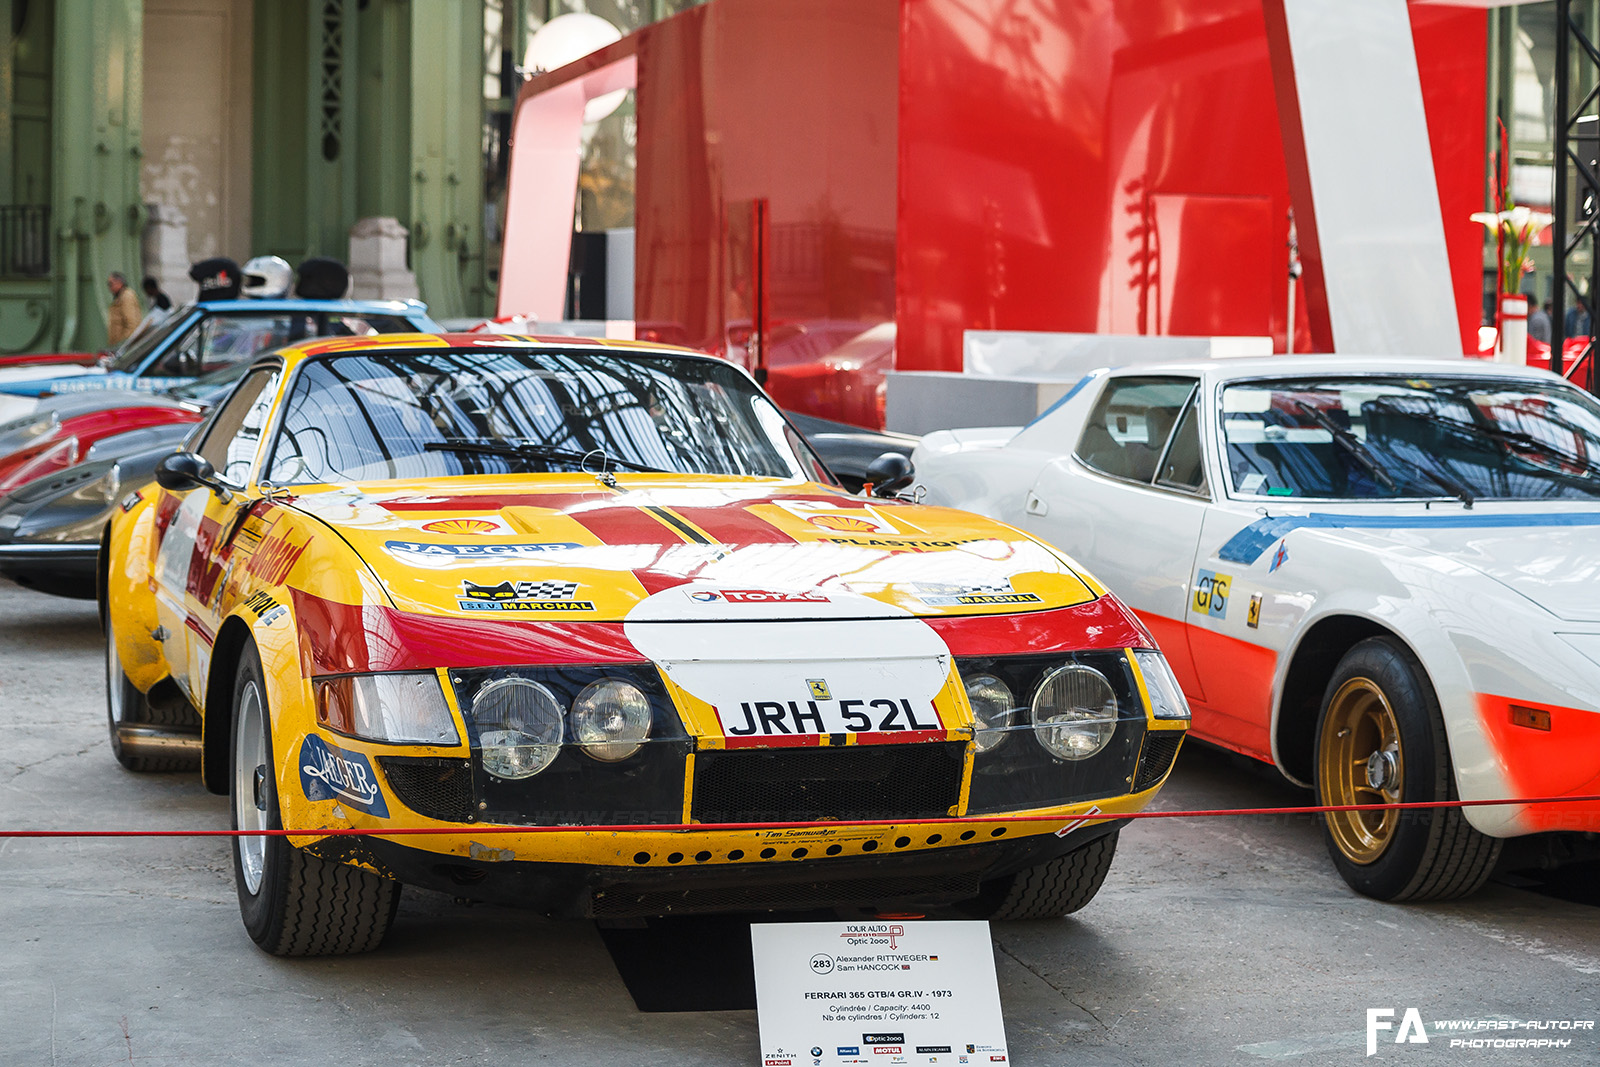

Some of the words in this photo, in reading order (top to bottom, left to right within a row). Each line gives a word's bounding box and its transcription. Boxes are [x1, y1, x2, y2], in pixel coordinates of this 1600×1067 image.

[724, 592, 826, 601] TOTAL
[1197, 576, 1227, 612] GTS
[959, 593, 1038, 605] MARCHAL
[502, 602, 592, 611] MARCHAL
[728, 701, 826, 735] JRH
[839, 698, 939, 732] 52L
[303, 745, 378, 806] JAEGER
[765, 830, 783, 838] Tim
[784, 829, 837, 838] Samways
[846, 925, 867, 933] TOUR
[847, 938, 868, 946] Optic
[836, 955, 875, 963] Alexander
[876, 954, 928, 962] RITTWEGER
[812, 959, 831, 968] 283
[837, 964, 856, 972] Sam
[857, 963, 901, 971] HANCOCK
[804, 991, 848, 1000] FERRARI
[849, 991, 866, 999] 365
[867, 990, 896, 999] GTB/4
[897, 990, 924, 998] GR.IV
[931, 990, 953, 998] 1973
[829, 1004, 867, 1013] Cylindrée
[873, 1003, 910, 1012] Capacity:
[911, 1003, 931, 1011] 4400
[847, 1013, 883, 1022] cylindres
[889, 1012, 928, 1021] Cylinders:
[930, 1012, 940, 1020] 12
[874, 1047, 902, 1055] MOTUL
